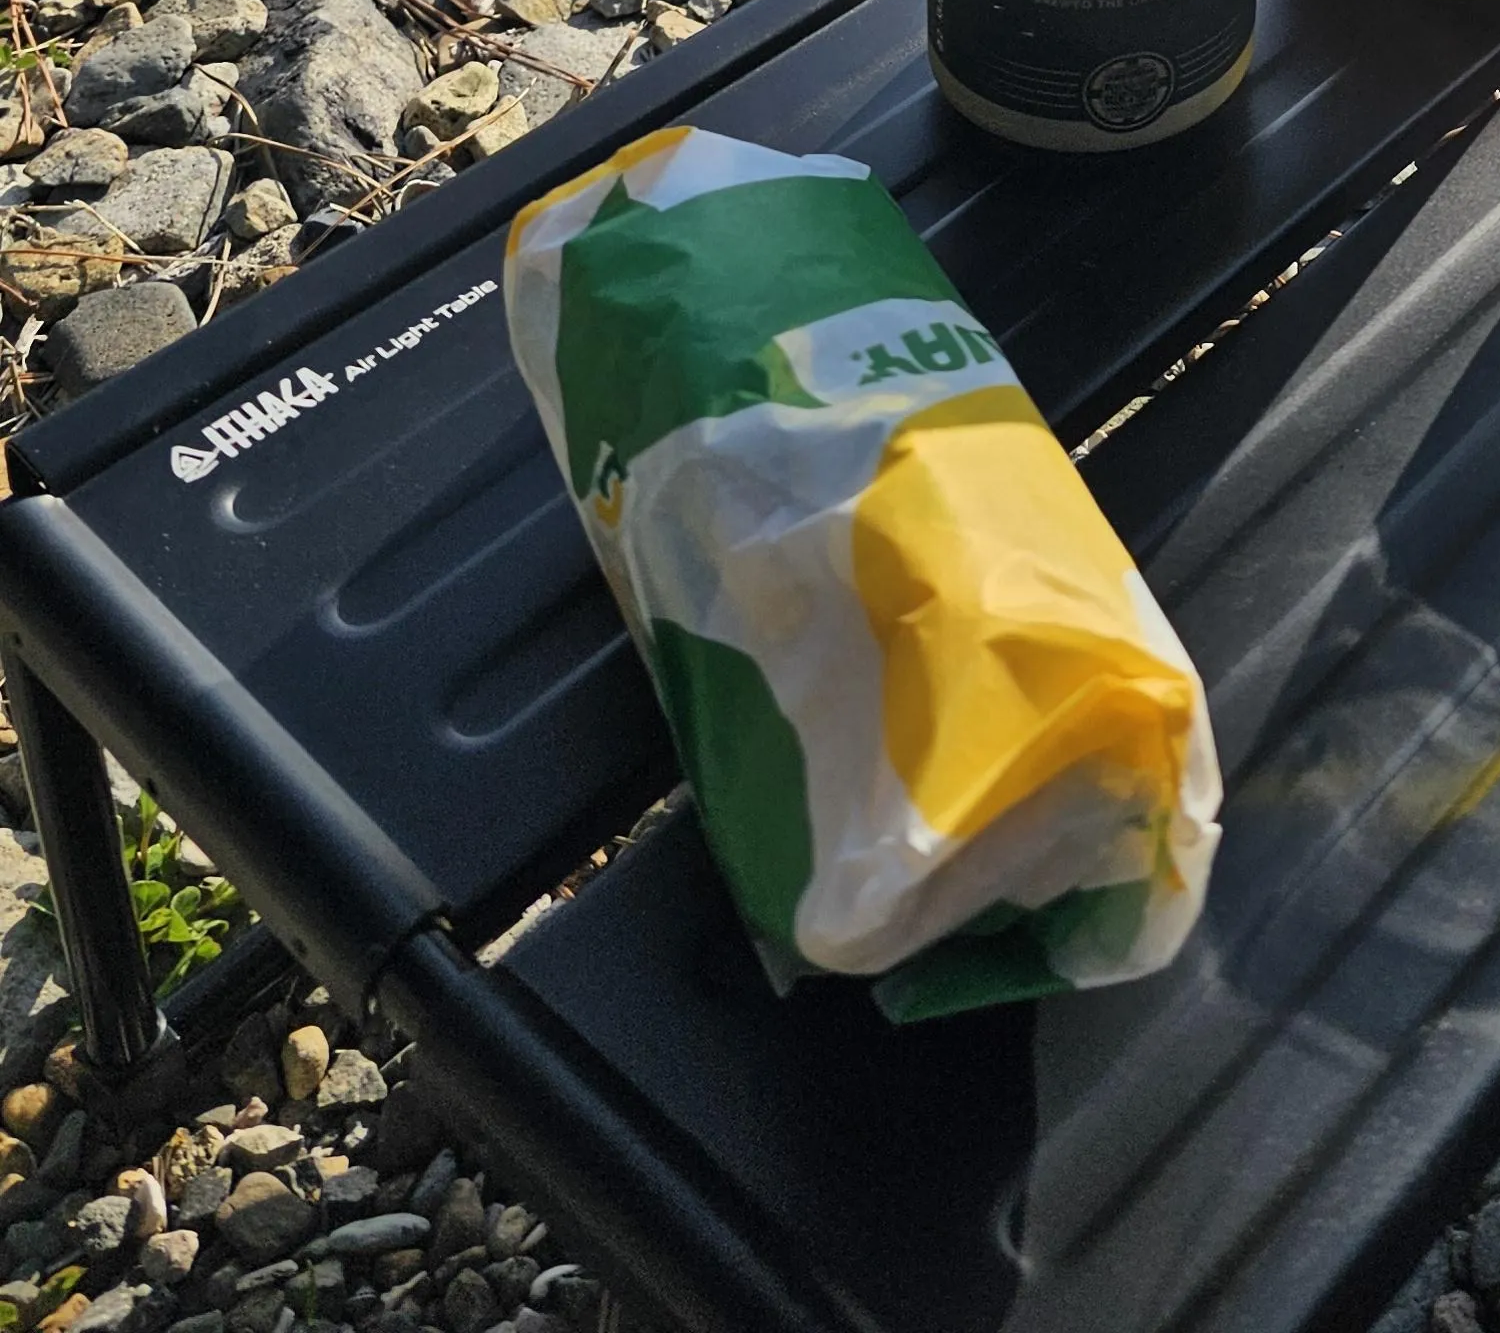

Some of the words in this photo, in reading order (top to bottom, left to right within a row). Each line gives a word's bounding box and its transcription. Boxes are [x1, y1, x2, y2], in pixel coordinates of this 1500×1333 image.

[202, 366, 339, 459] ITHAKA
[344, 354, 378, 382] Air
[375, 317, 440, 360] Light
[433, 280, 498, 319] Table
